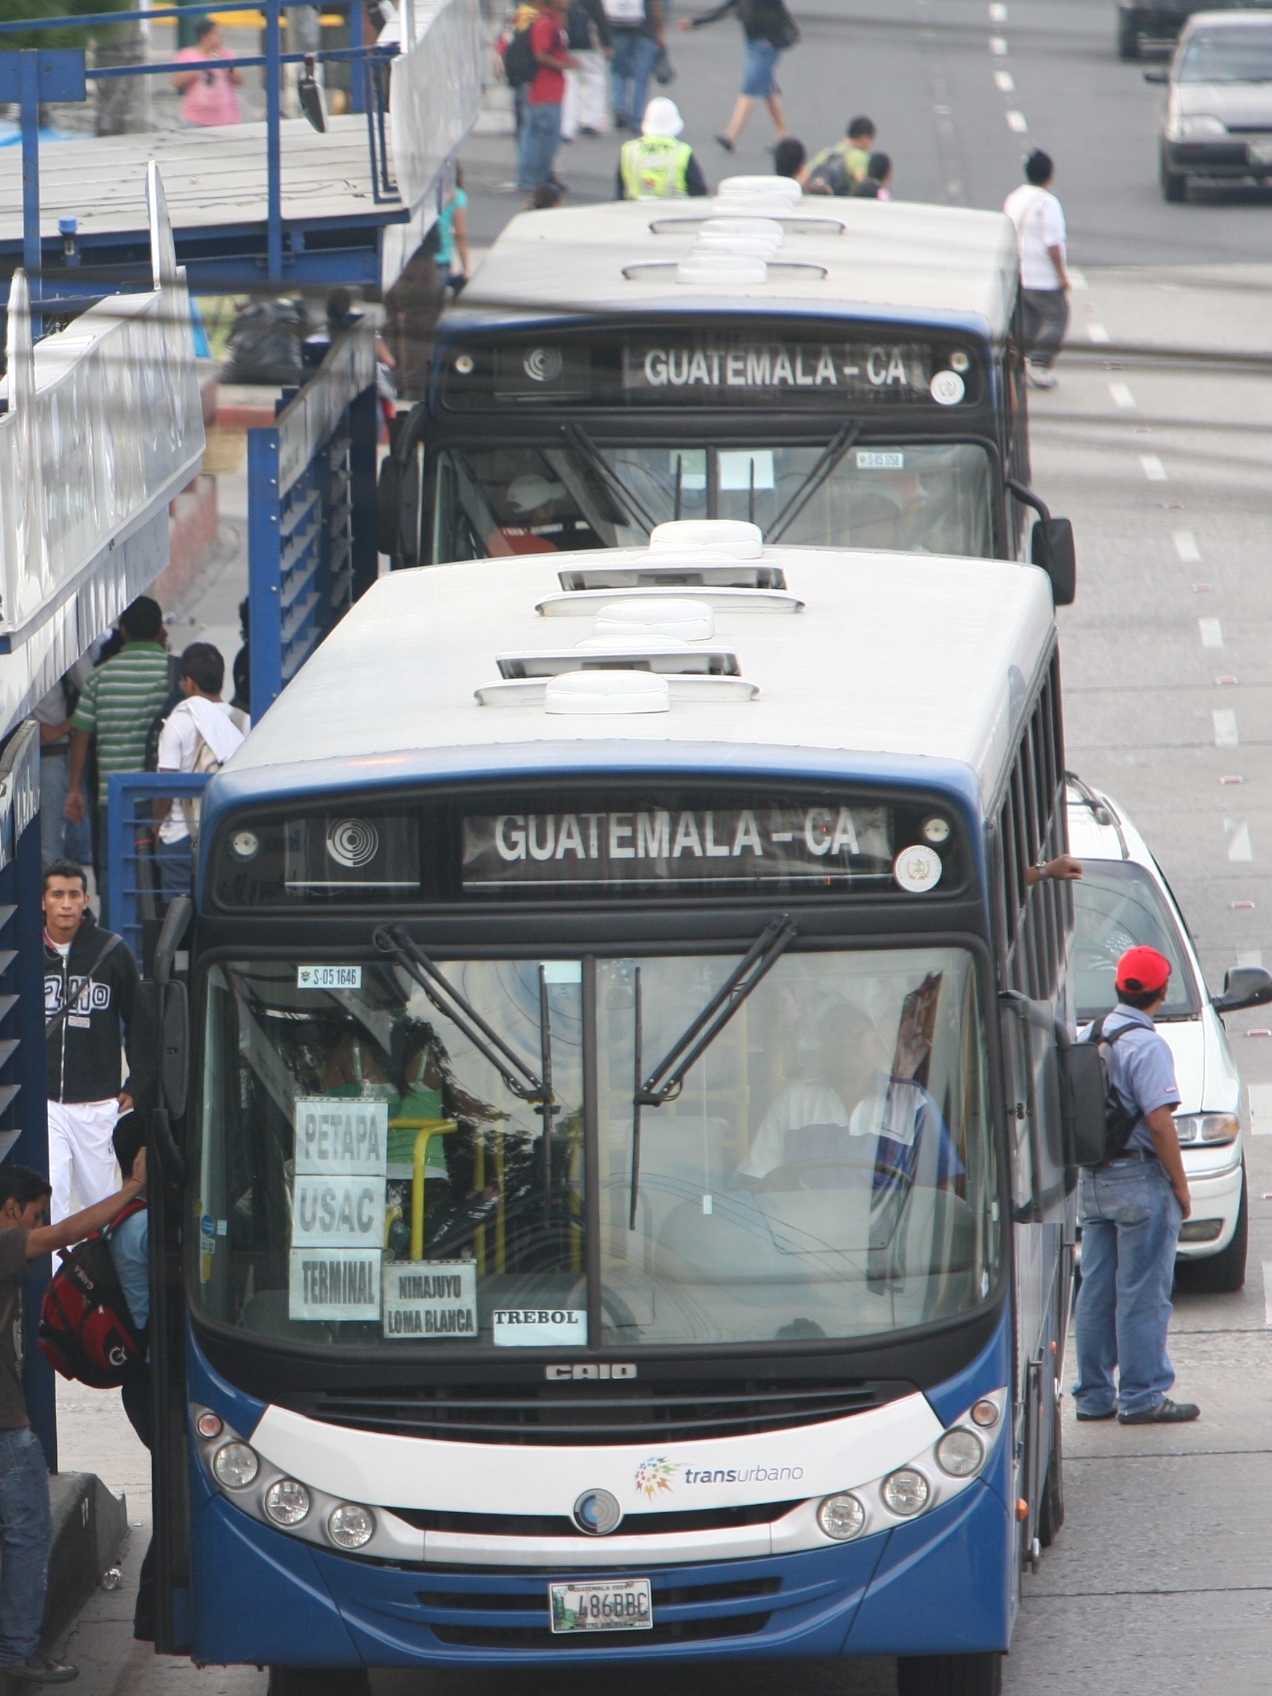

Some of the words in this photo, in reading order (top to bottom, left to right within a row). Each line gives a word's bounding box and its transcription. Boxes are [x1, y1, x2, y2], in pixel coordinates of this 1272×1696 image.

[644, 346, 837, 386] GUATEMALA
[866, 346, 906, 386] CA
[495, 810, 763, 861] GUATEMALA
[804, 807, 860, 858] CA
[313, 968, 334, 985] S-05
[336, 968, 357, 985] 1646
[305, 1114, 380, 1161] PETAPA
[299, 1187, 375, 1234] USAC
[302, 1260, 375, 1304] TERMINAL
[399, 1275, 462, 1299] NIMAJUYU
[388, 1310, 423, 1334] LOMA
[425, 1309, 474, 1333] BLANCA
[494, 1311, 579, 1324] TREBOL
[546, 1363, 637, 1380] CAIO
[685, 1465, 804, 1484] transurbano
